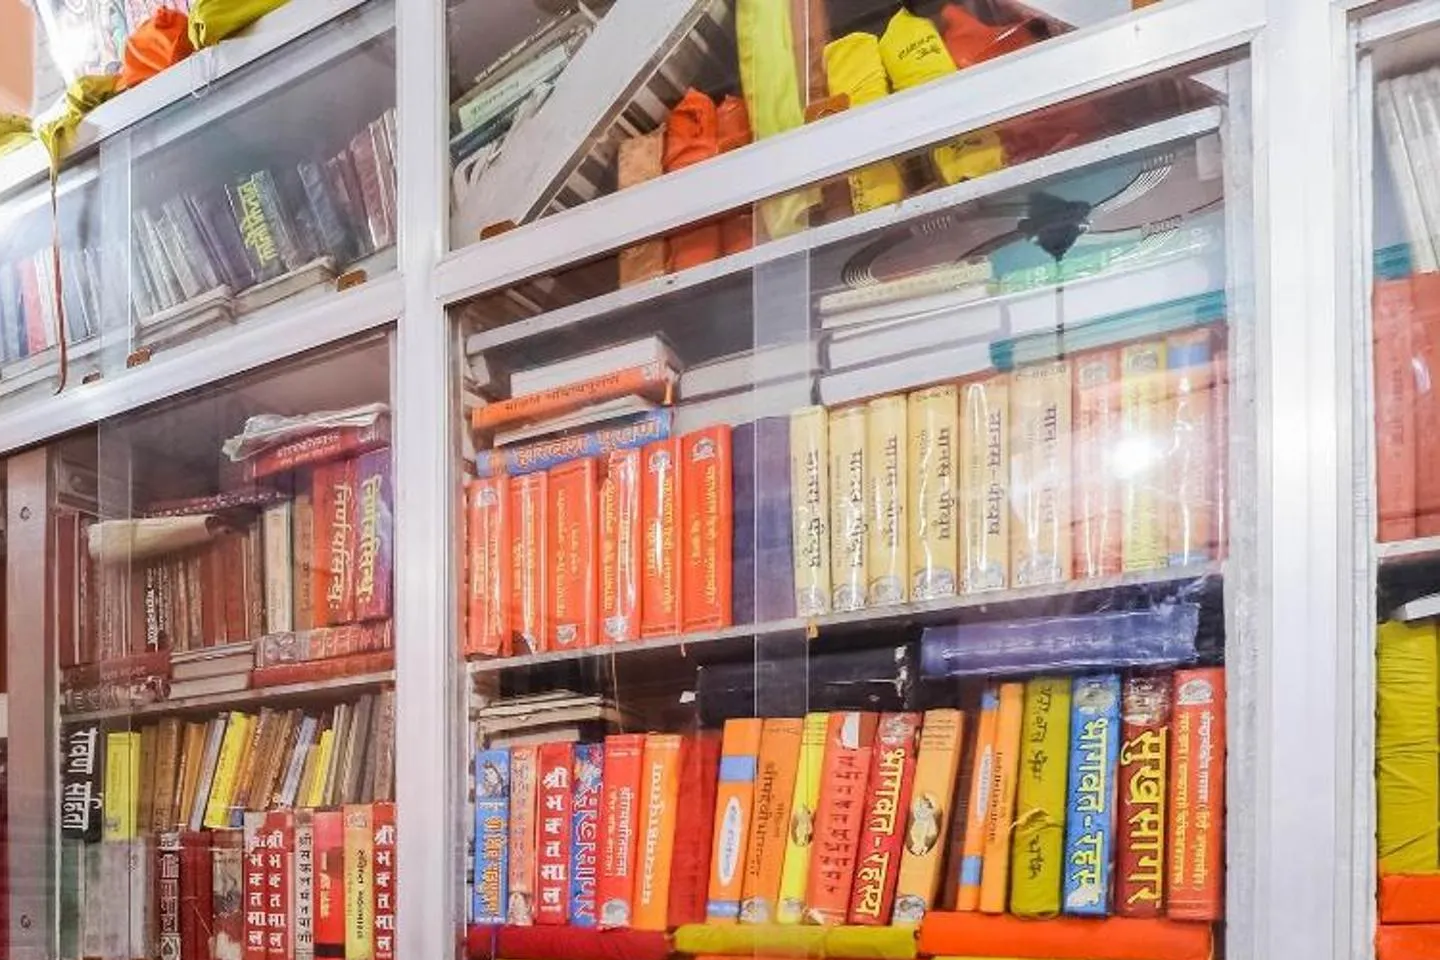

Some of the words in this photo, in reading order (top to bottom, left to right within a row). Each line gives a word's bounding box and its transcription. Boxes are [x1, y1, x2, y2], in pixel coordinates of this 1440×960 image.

[67, 727, 98, 775] रावण
[854, 746, 906, 919] भागवत-रहस्य
[1120, 726, 1169, 909] सुखसागर
